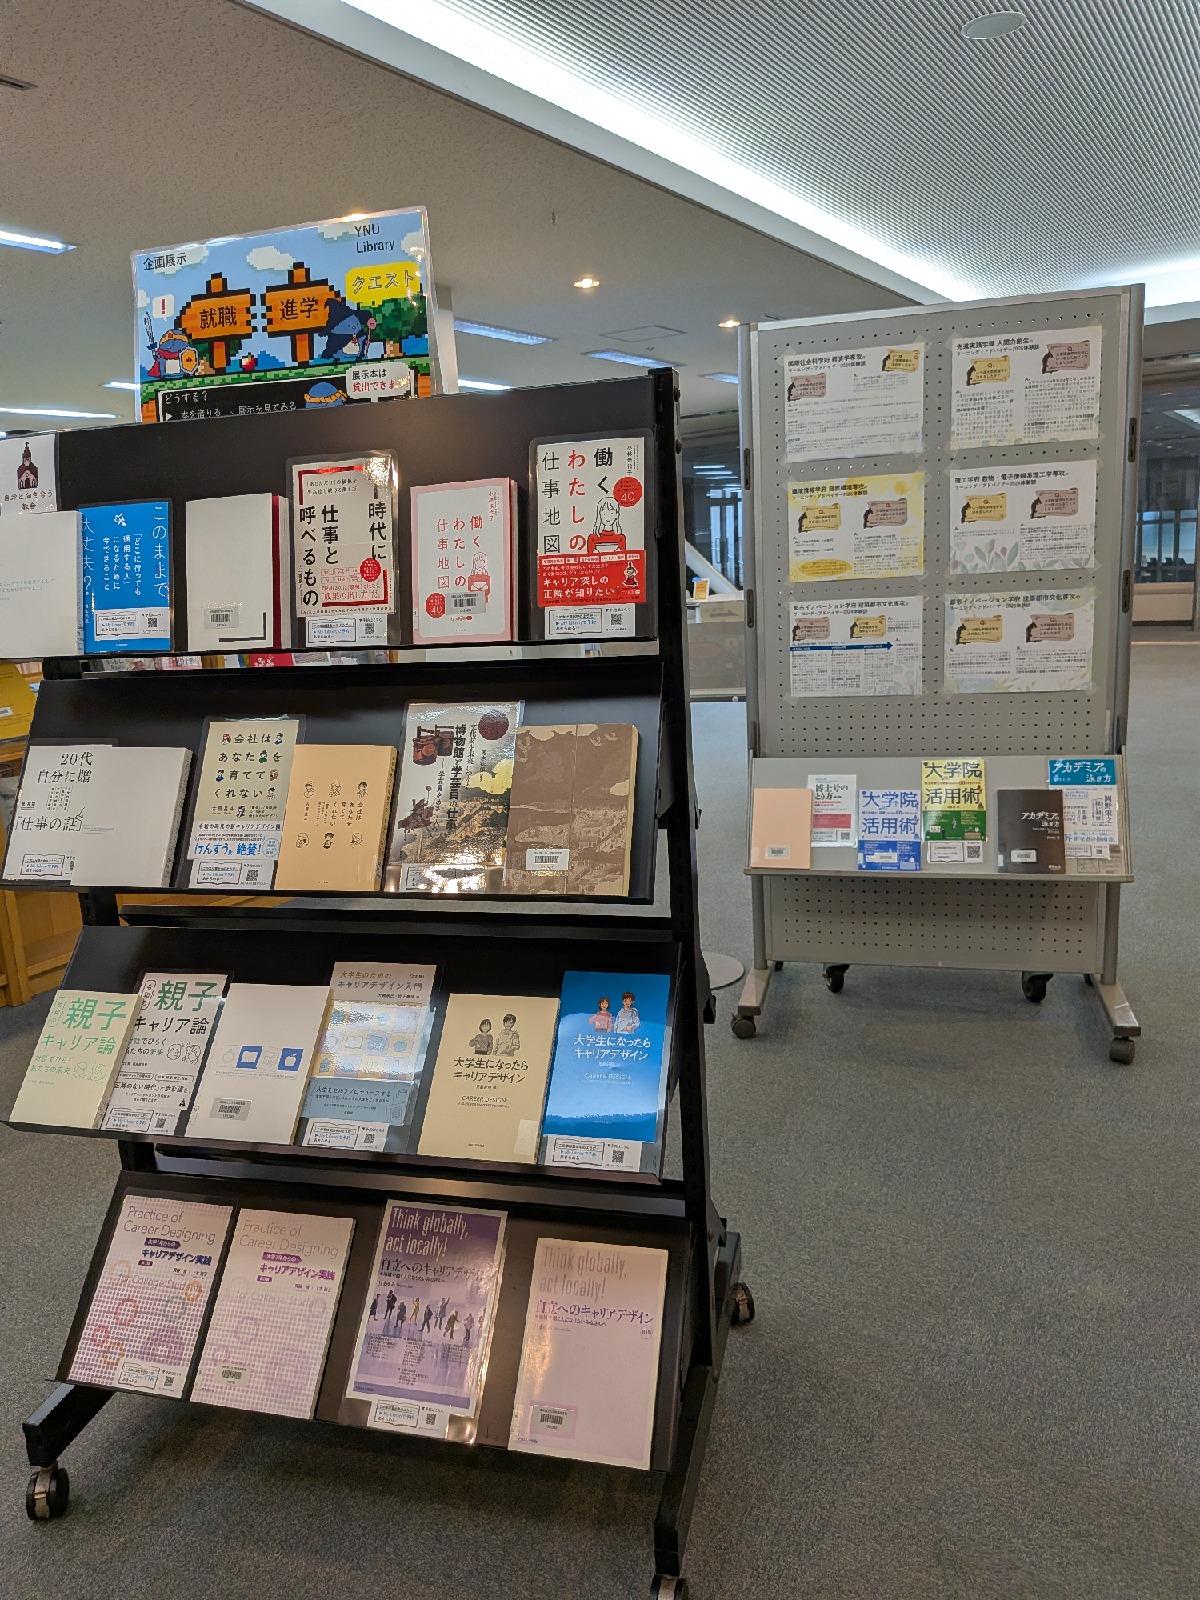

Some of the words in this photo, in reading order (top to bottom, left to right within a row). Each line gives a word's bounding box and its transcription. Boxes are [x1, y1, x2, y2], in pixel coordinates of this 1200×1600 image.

[354, 224, 379, 237] YNU
[356, 240, 395, 254] Library
[143, 252, 187, 271] 企画展示
[352, 269, 415, 294] クエスト
[199, 308, 238, 330] 就職
[278, 297, 319, 322] 進学
[352, 369, 386, 381] 展示本は
[594, 447, 613, 494] 働く
[542, 451, 561, 555] 仕事地図
[567, 449, 587, 551] わたしの
[321, 504, 339, 566] 仕事と
[469, 515, 483, 548] 働く
[152, 506, 169, 599] このままで
[299, 505, 319, 607] 呼べるもの
[437, 518, 450, 590] 仕事地図
[453, 517, 466, 587] わたしの
[233, 733, 271, 744] 会社は
[60, 751, 94, 767] 20代
[218, 751, 283, 763] あなたを
[229, 769, 266, 781] 育てて
[924, 762, 983, 779] 大学院
[1052, 761, 1107, 774] アカデミアの
[214, 788, 263, 799] くれない
[862, 791, 919, 808] 大学院
[924, 787, 983, 805] 活用術
[862, 817, 918, 835] 活用術
[337, 980, 423, 991] キャリアデザイン入門
[154, 980, 218, 1012] 親子
[63, 997, 127, 1031] 親子
[134, 1016, 210, 1035] キャリア論
[40, 1033, 117, 1055] キャリア論
[573, 1034, 651, 1048] 大学生になったら
[453, 1057, 529, 1071] 大学生になったら
[574, 1047, 649, 1061] キャリアデザイン
[453, 1071, 526, 1083] キャリアデザイン
[126, 1206, 169, 1222] Practice
[171, 1210, 185, 1223] of
[391, 1207, 422, 1231] Think
[421, 1213, 469, 1239] globally,
[123, 1220, 160, 1235] Career
[161, 1224, 216, 1245] Designing
[242, 1220, 286, 1236] Practice
[289, 1223, 303, 1236] of
[239, 1235, 276, 1249] Career
[280, 1238, 339, 1259] Designing
[385, 1235, 404, 1252] act
[405, 1238, 448, 1262] locally!
[380, 1258, 484, 1281] 自立へのキャリアデザイ
[543, 1246, 573, 1270] Think
[577, 1250, 628, 1278] globally,
[539, 1274, 558, 1295] act
[561, 1275, 606, 1303] locally!
